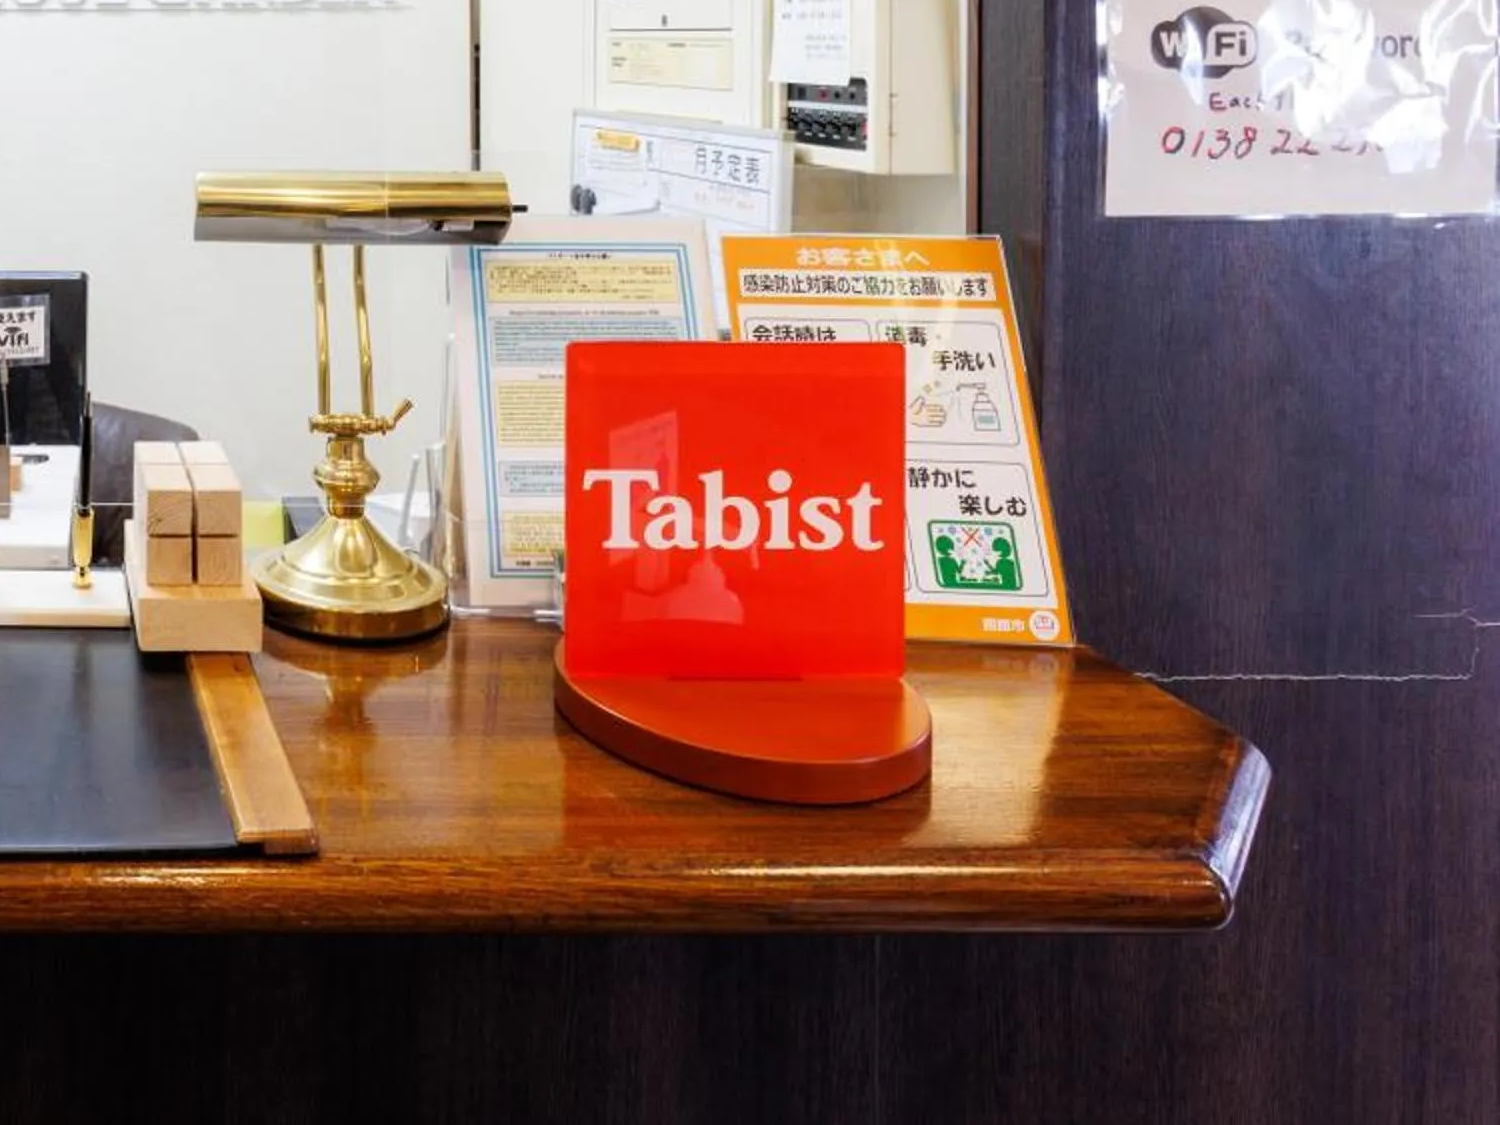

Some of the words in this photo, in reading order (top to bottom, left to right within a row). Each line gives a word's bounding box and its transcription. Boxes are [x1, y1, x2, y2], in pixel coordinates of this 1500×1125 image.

[1161, 125, 1258, 160] 0138
[796, 246, 930, 268] お客さまへ
[932, 350, 997, 373] 手洗い
[907, 466, 977, 489] 静かに
[582, 469, 885, 551] Tabist
[958, 493, 1028, 517] 楽しむ
